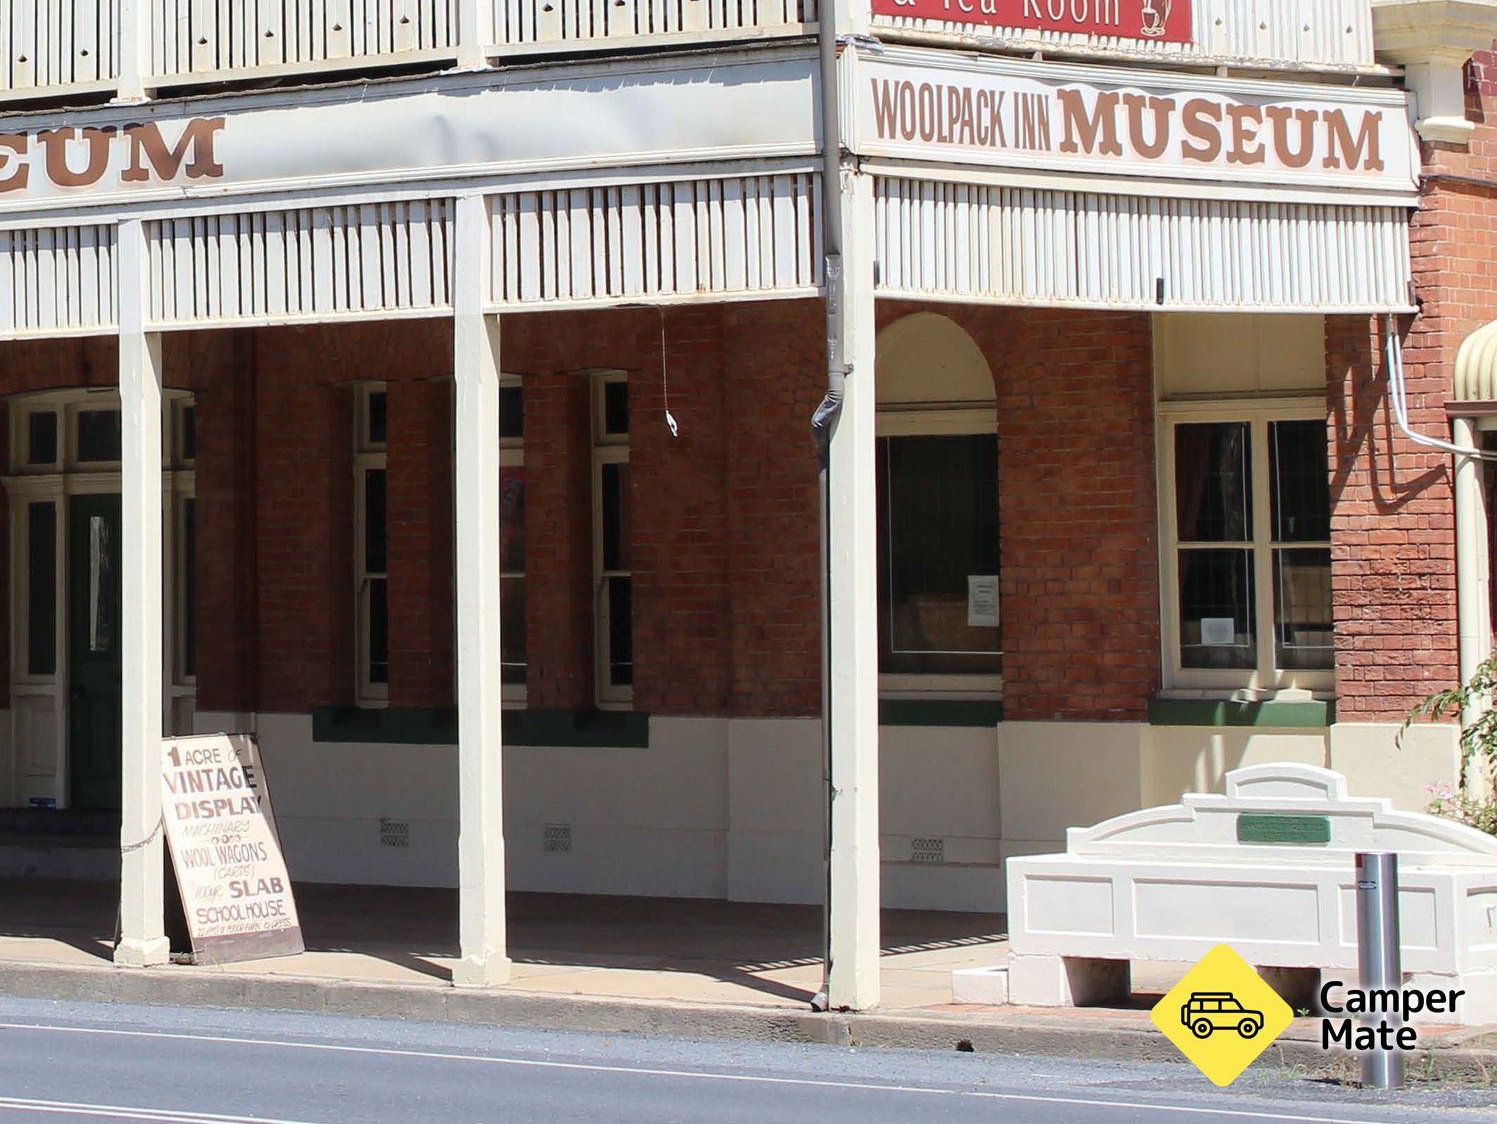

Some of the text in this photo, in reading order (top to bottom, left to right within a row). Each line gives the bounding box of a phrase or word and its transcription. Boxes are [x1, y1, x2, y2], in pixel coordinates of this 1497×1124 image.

[871, 78, 1384, 172] WOOLPACK INN MUSEUM
[167, 747, 181, 767] 1
[185, 748, 222, 765] ACRE
[162, 765, 257, 794] VINTAGE
[174, 795, 261, 820] DISPLAY
[181, 842, 267, 869] WOOL WAGONS
[229, 877, 284, 898] SLAB
